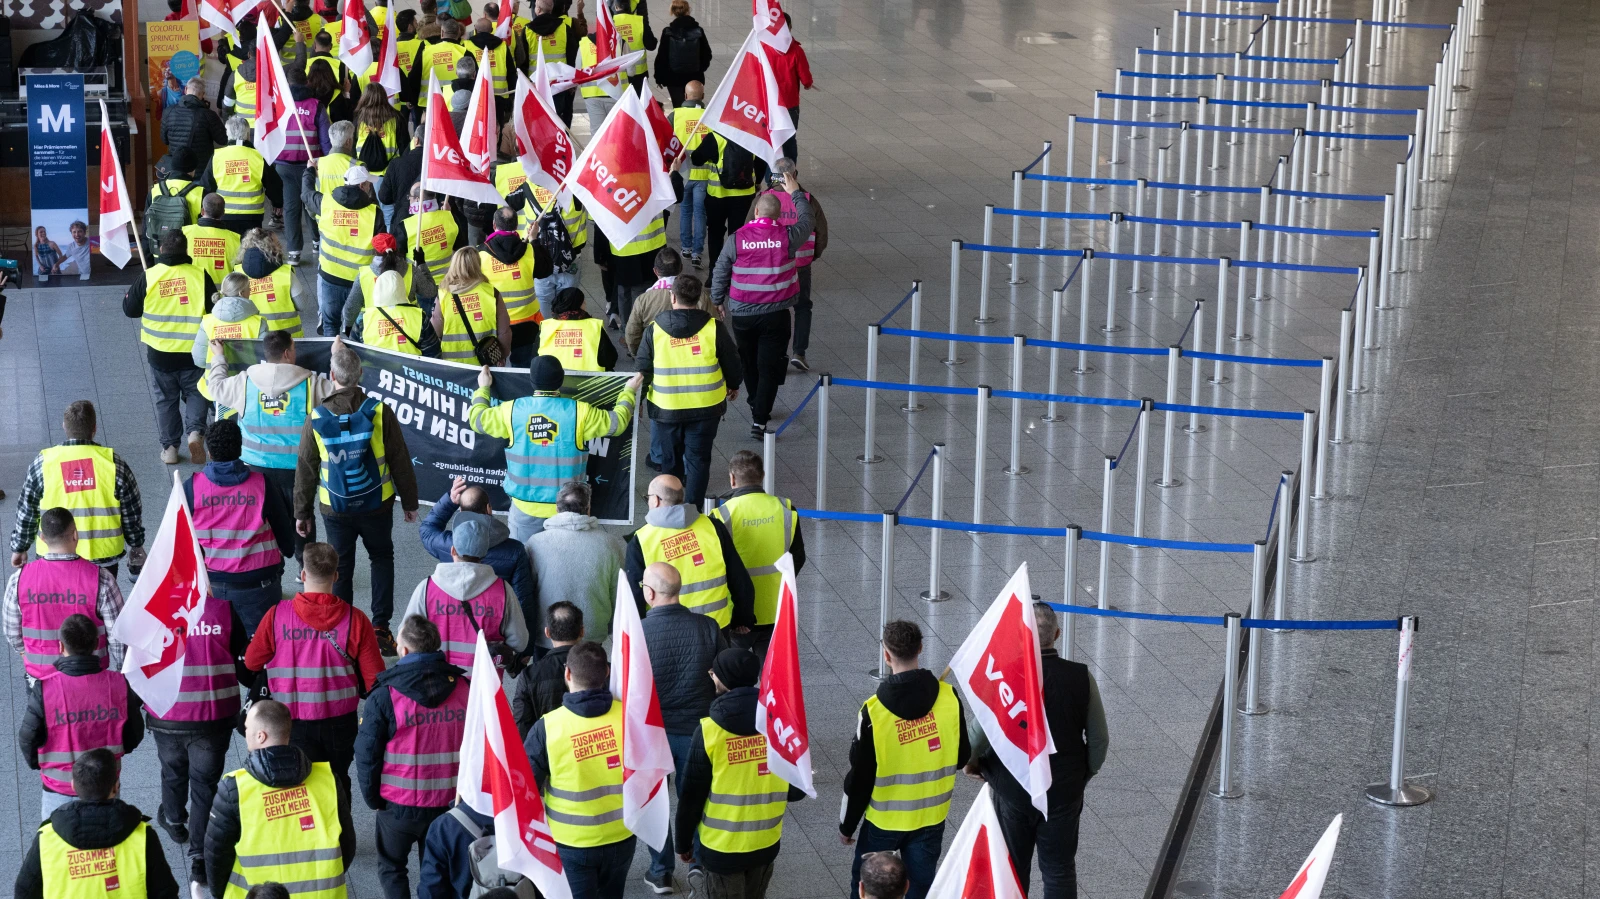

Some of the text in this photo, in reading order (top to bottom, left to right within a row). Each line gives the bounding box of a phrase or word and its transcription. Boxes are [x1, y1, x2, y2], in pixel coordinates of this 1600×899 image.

[151, 34, 190, 42] SPRINGTIME
[589, 153, 642, 213] ver.di
[194, 240, 225, 248] ZUSAMMEN
[742, 238, 781, 249] komba
[159, 279, 187, 289] ZUSAMMEN
[160, 286, 187, 296] GEHT MEHR
[530, 423, 552, 431] STOPP
[533, 431, 548, 439] BAR
[66, 477, 94, 486] ver.di
[202, 491, 256, 507] komba
[742, 515, 775, 528] Fraport
[661, 531, 696, 550] ZUSAMMEN
[665, 541, 700, 559] GEHT MEHR
[27, 589, 87, 605] komba
[55, 704, 119, 725] komba
[405, 705, 466, 727] komba
[896, 711, 935, 733] ZUSAMMEN
[571, 728, 615, 749] ZUSAMMEN
[898, 722, 937, 742] GEHT MEHR
[574, 739, 617, 760] GEHT MEHR
[728, 750, 747, 762] GEHT
[263, 787, 308, 806] ZUSAMMEN
[265, 799, 310, 818] GEHT MEHR
[67, 847, 115, 865] ZUSAMMEN
[69, 859, 117, 876] GEHT MEHR
